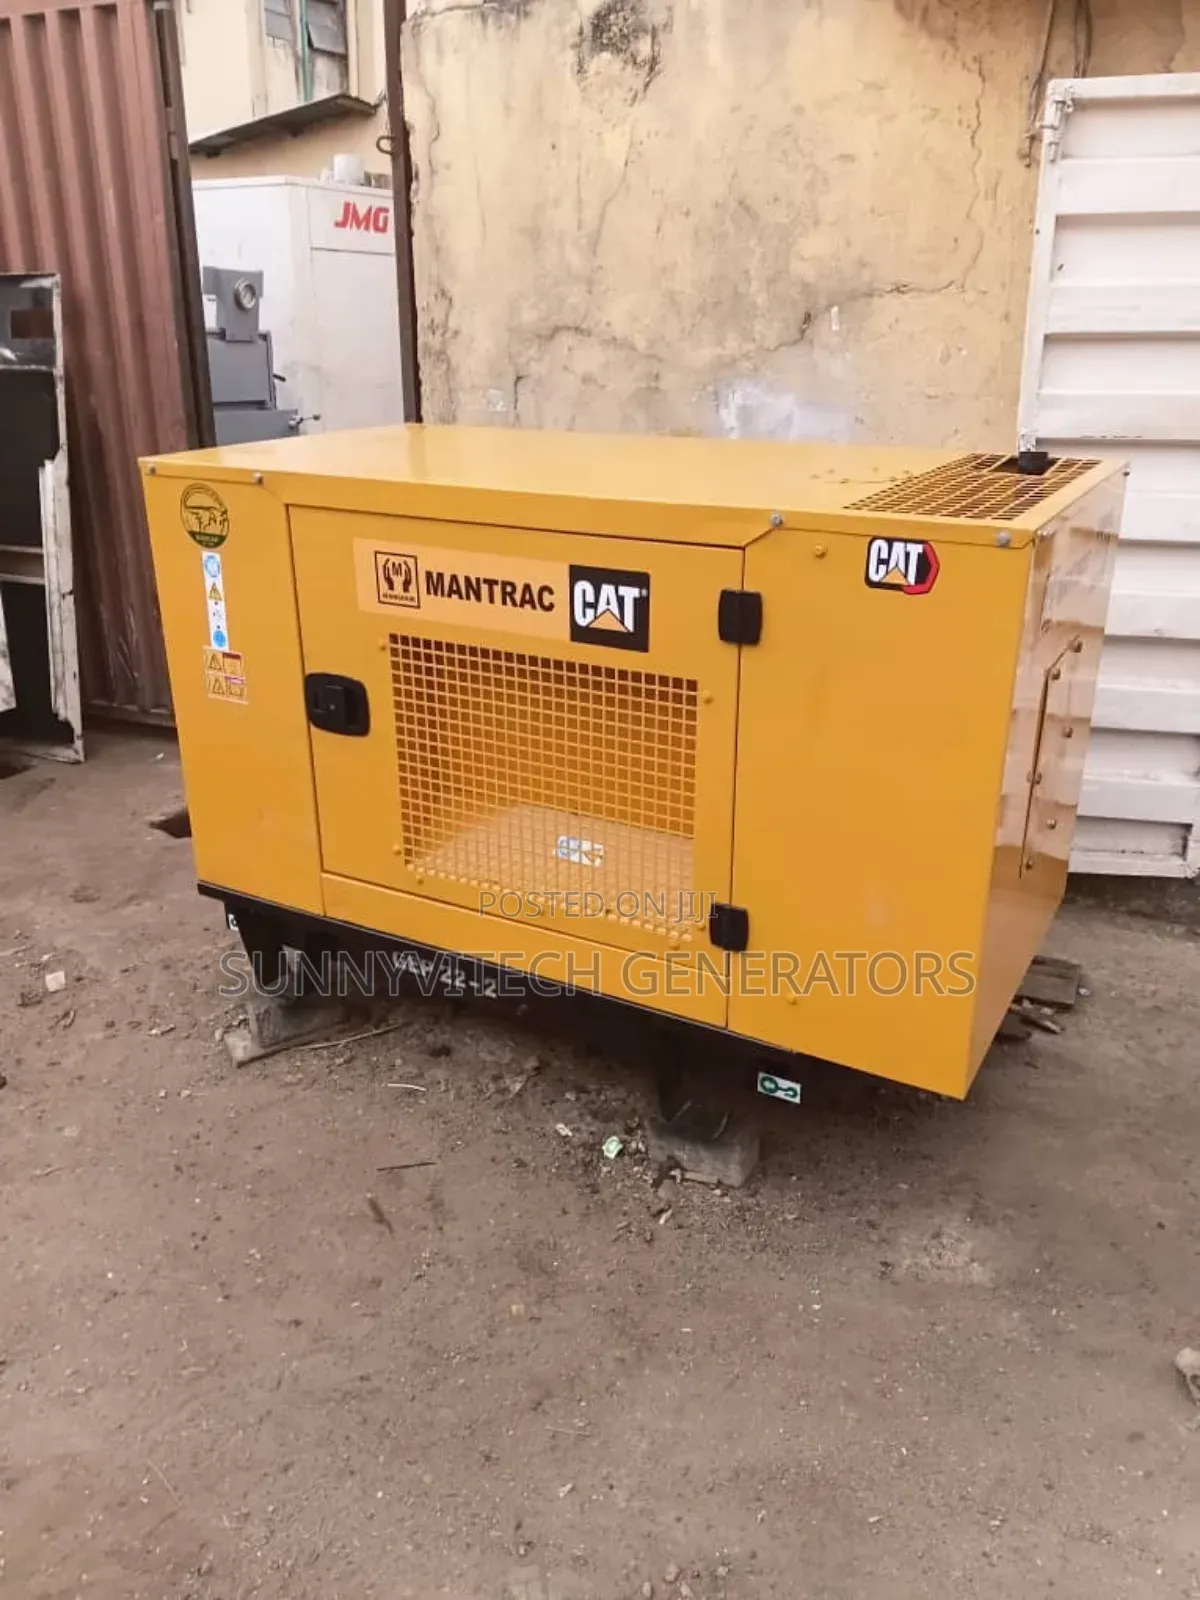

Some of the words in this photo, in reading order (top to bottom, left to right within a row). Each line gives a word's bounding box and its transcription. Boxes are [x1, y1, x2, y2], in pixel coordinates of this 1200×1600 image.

[334, 200, 390, 233] JMG
[868, 539, 923, 586] CAT
[425, 570, 555, 612] MANTRAC
